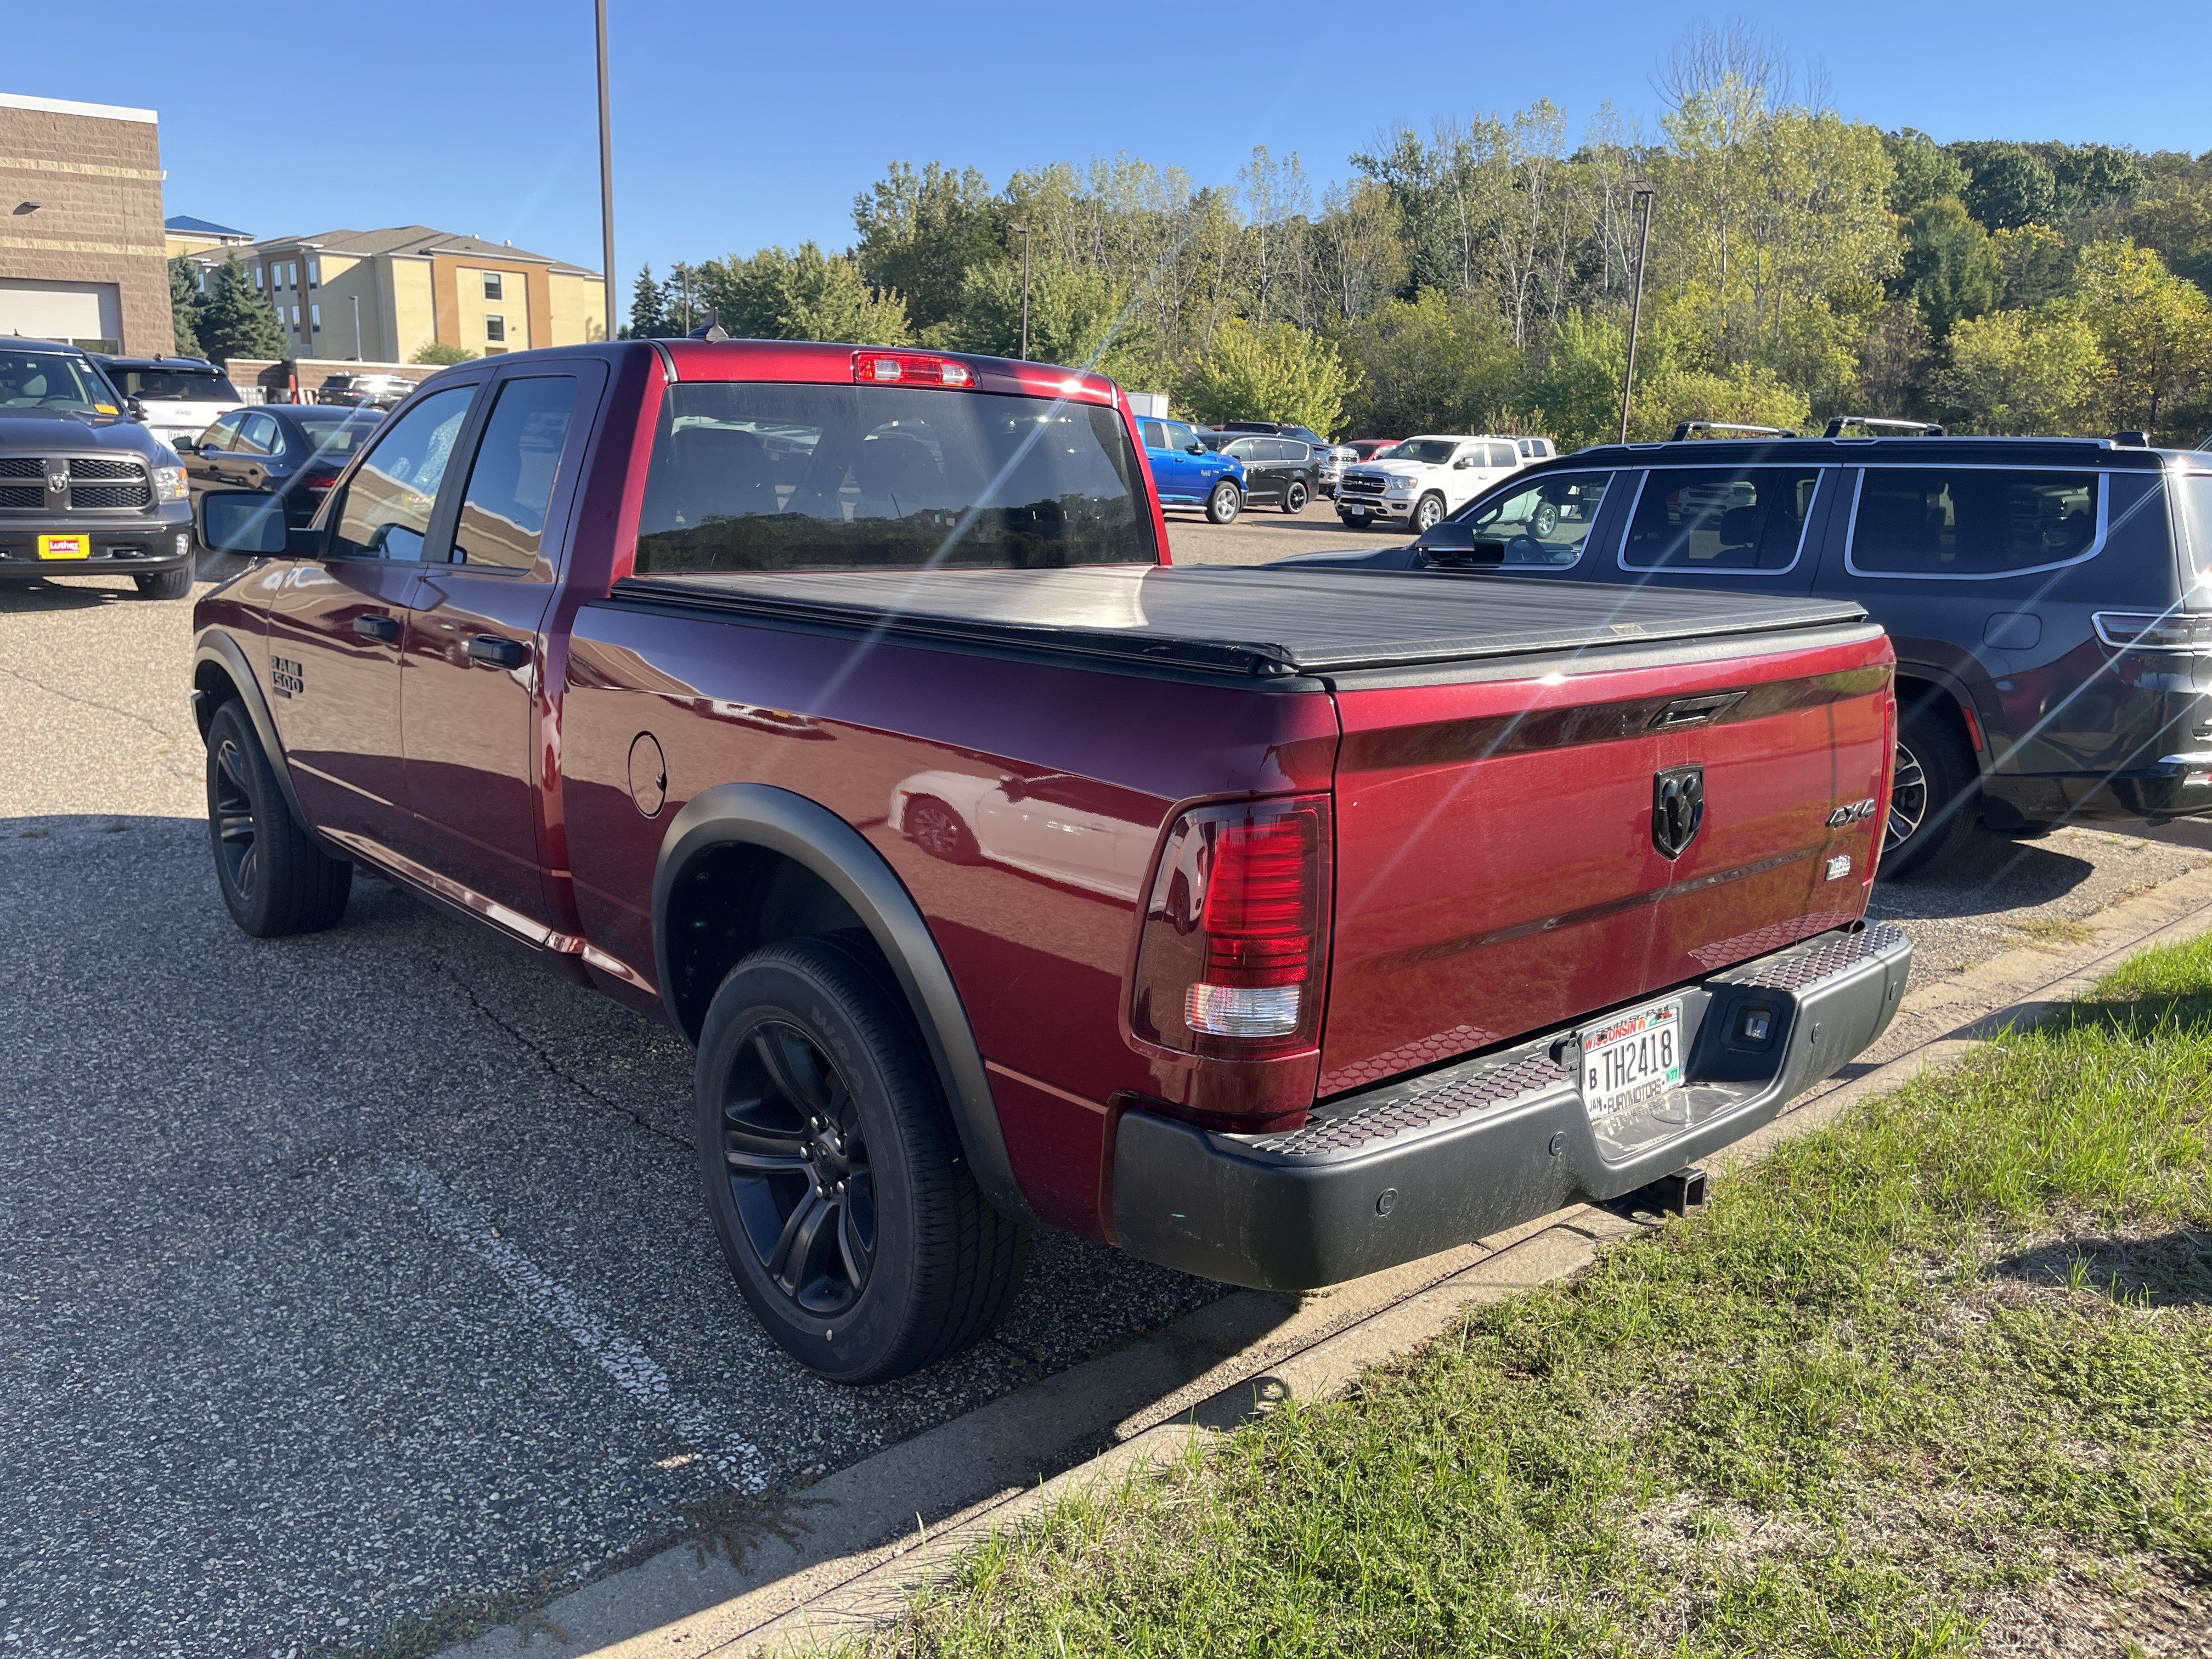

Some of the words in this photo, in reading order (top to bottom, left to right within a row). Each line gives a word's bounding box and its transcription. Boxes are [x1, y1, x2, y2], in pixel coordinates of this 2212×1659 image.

[49, 541, 79, 550] Luther
[270, 655, 302, 677] RAM
[1602, 1029, 1673, 1092] TH2418
[1589, 1068, 1598, 1091] B
[1671, 1069, 1678, 1081] 27
[1589, 1096, 1602, 1113] JAN
